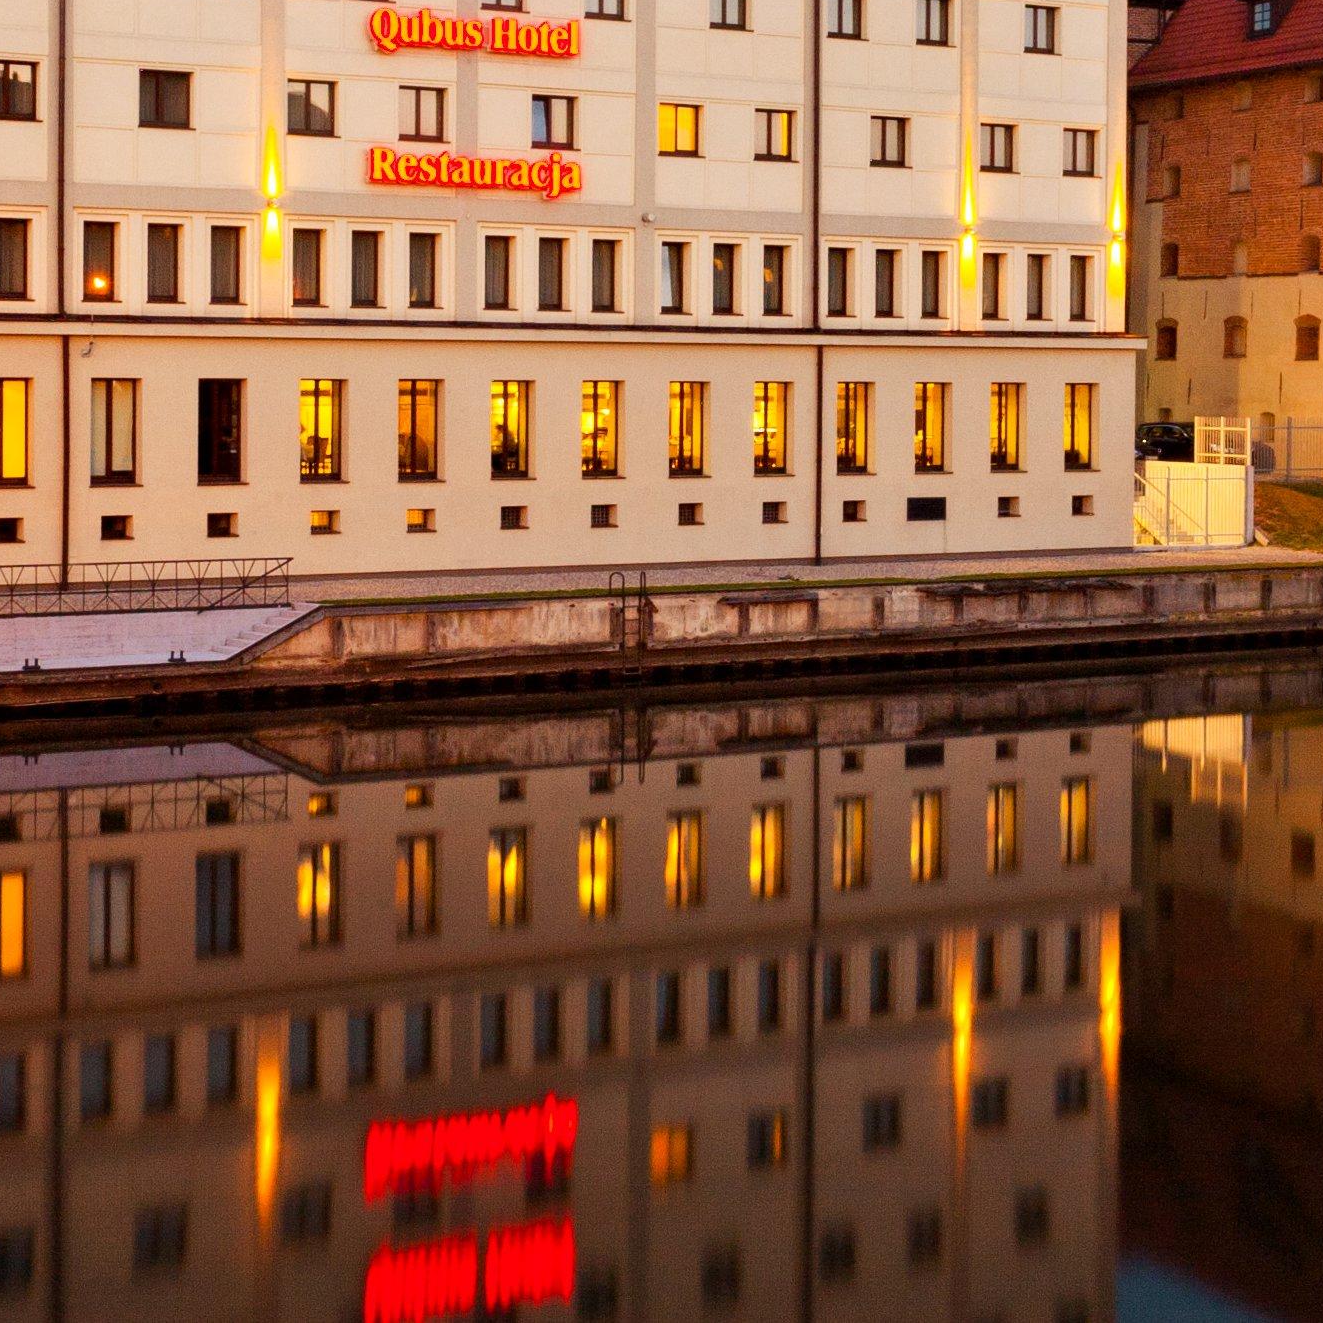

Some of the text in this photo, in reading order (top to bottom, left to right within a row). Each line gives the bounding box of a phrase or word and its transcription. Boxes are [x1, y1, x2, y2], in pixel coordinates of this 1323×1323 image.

[369, 7, 580, 57] Qubus Hotel
[367, 146, 582, 199] Restauracja
